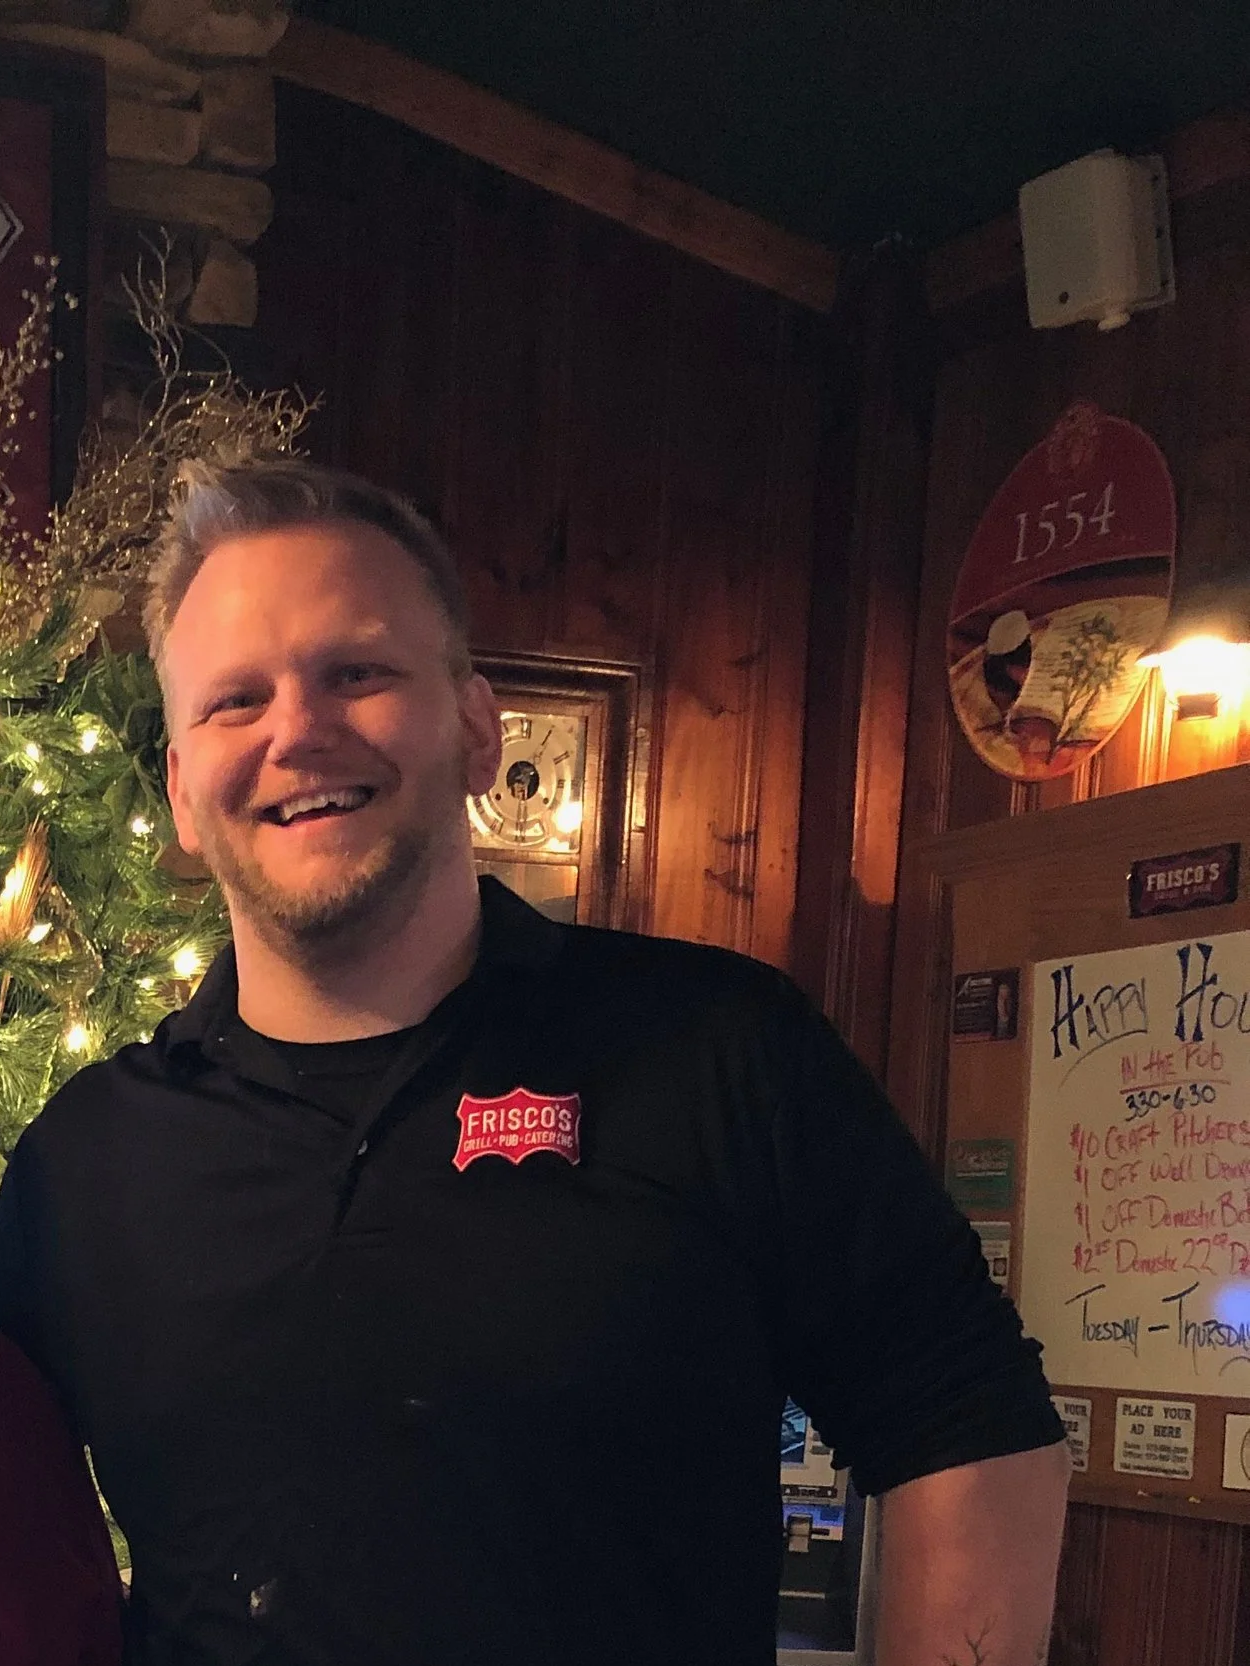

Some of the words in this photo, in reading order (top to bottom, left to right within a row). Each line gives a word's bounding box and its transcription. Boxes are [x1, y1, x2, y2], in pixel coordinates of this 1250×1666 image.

[1012, 482, 1115, 564] 1554
[1146, 863, 1220, 891] FRISCO'S
[1051, 964, 1149, 1059] HAPPY
[467, 1104, 572, 1137] FRISCO'S
[464, 1134, 493, 1153] GRILL
[499, 1133, 519, 1147] PUB
[524, 1131, 574, 1149] CATERING
[1065, 1283, 1141, 1358] TUESDAY
[1064, 1403, 1088, 1417] YOUR
[1122, 1404, 1154, 1418] PLACE
[1163, 1407, 1192, 1421] YOUR
[1130, 1423, 1145, 1435] AD
[1153, 1425, 1182, 1439] HERE
